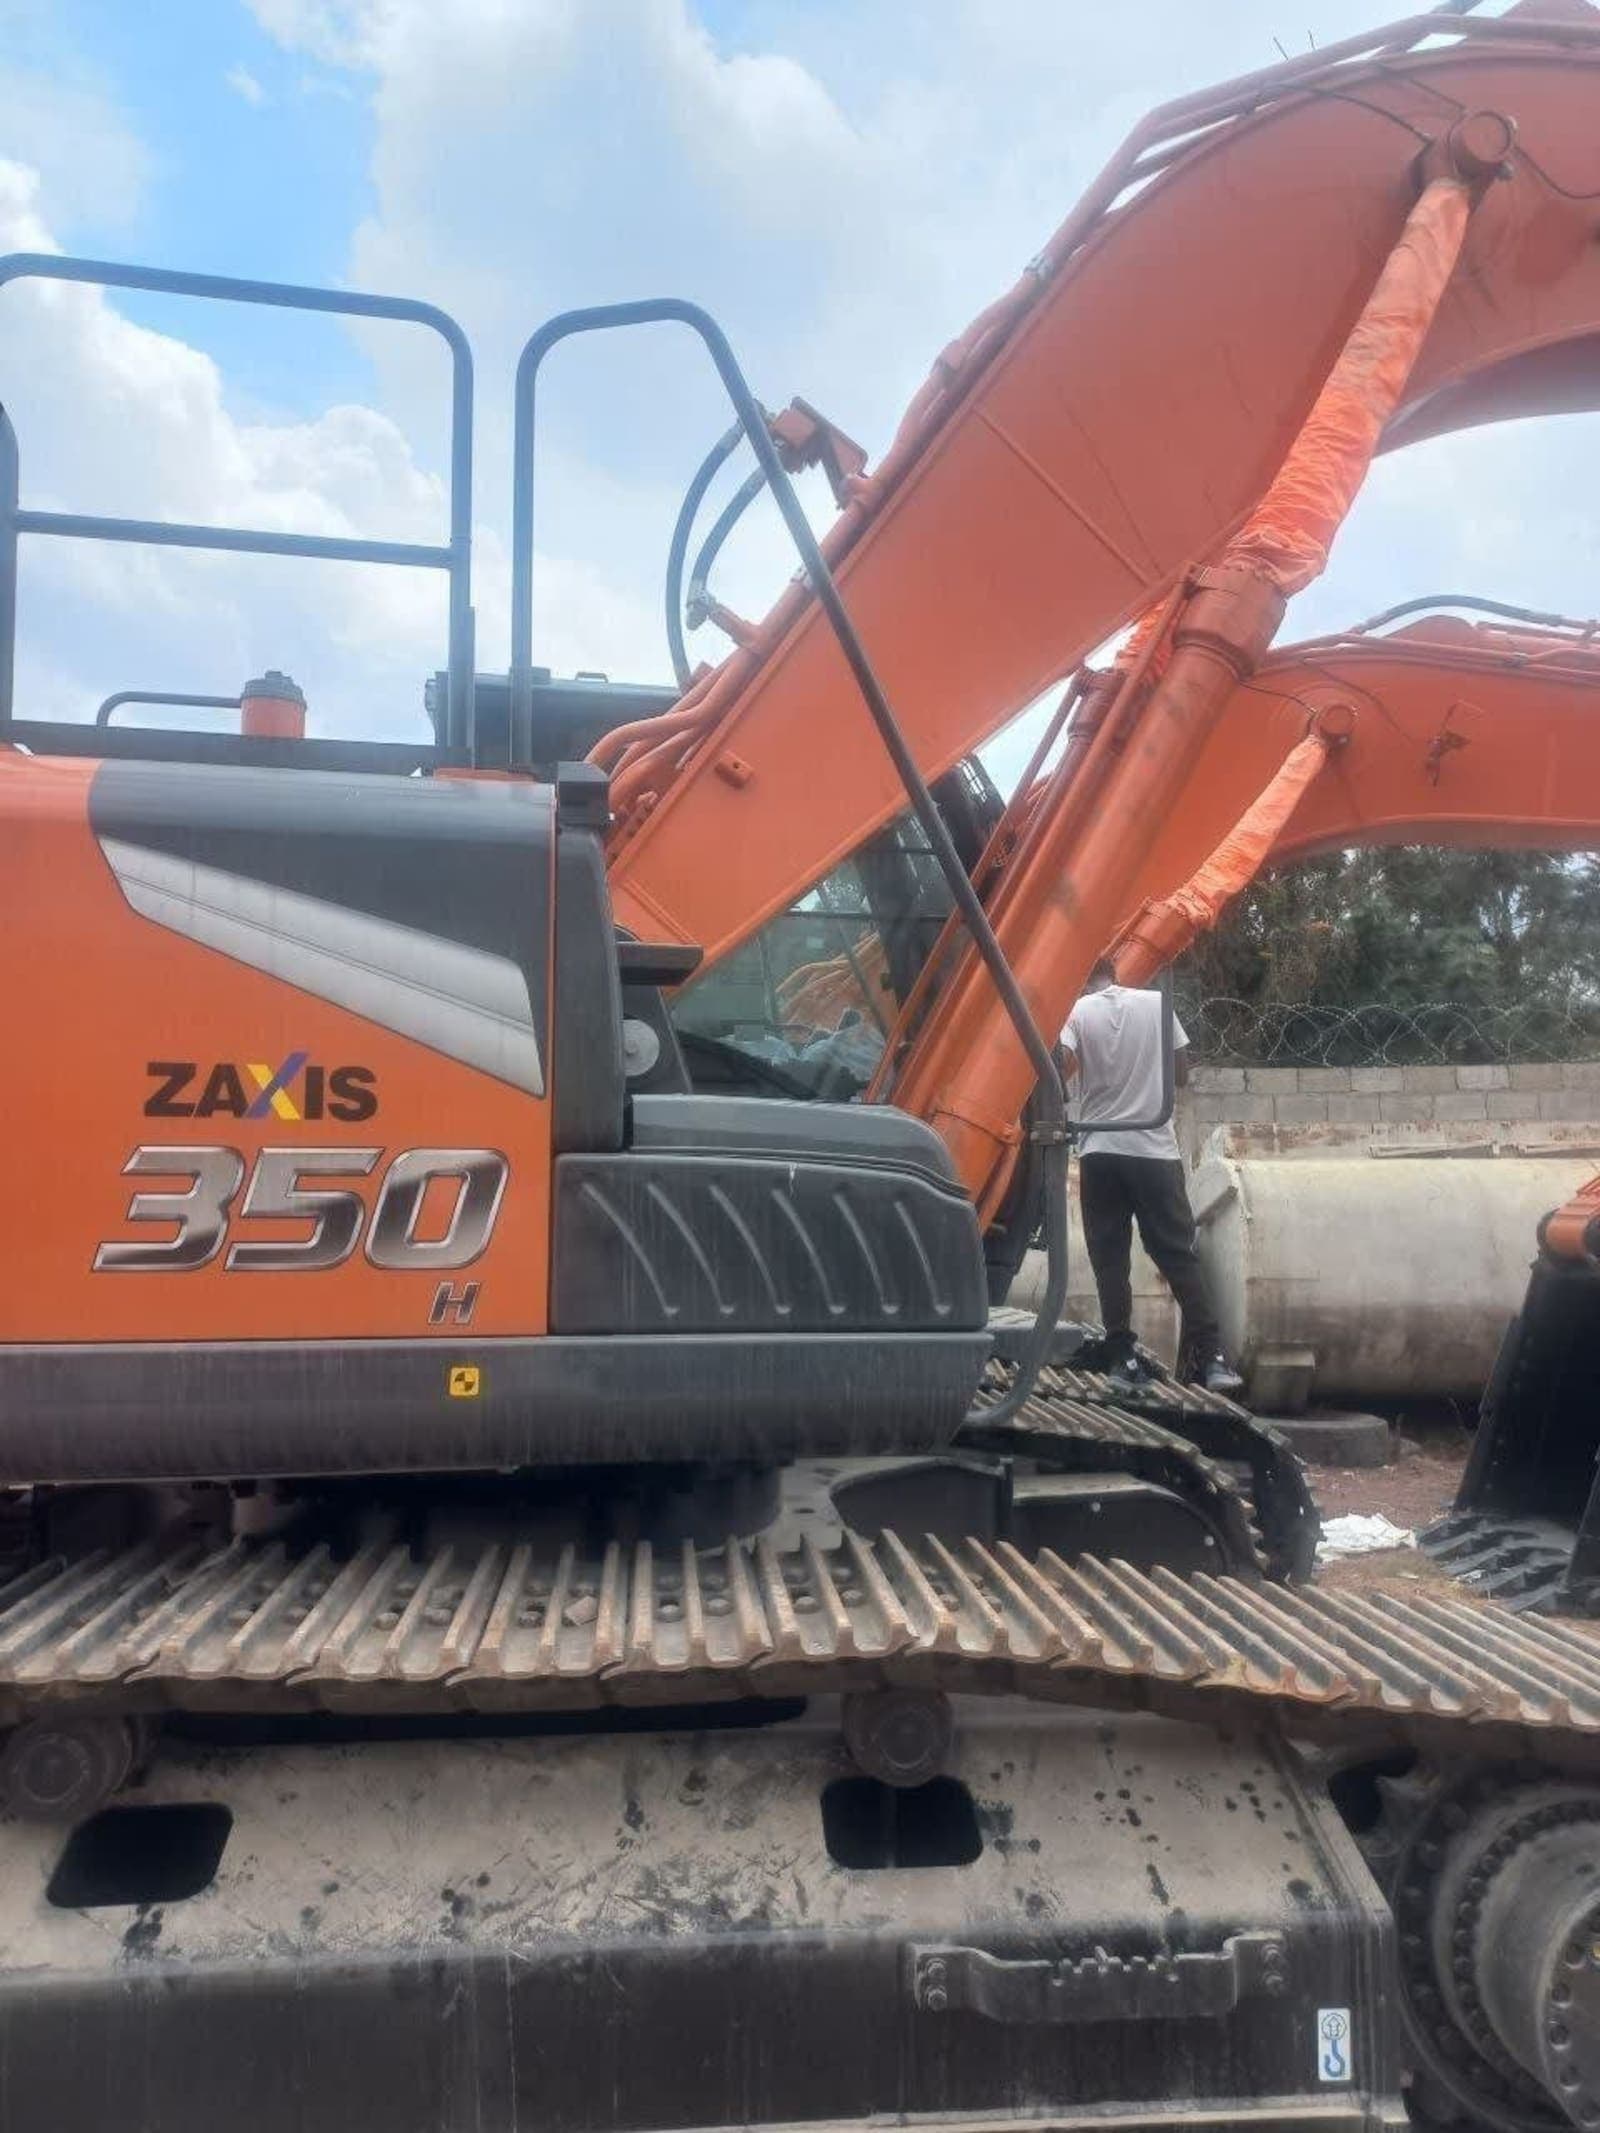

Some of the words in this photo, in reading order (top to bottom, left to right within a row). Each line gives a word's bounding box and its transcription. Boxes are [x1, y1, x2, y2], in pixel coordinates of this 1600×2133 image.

[144, 1051, 378, 1121] ZAXIS
[91, 1145, 510, 1272] 350
[428, 1282, 481, 1325] H
